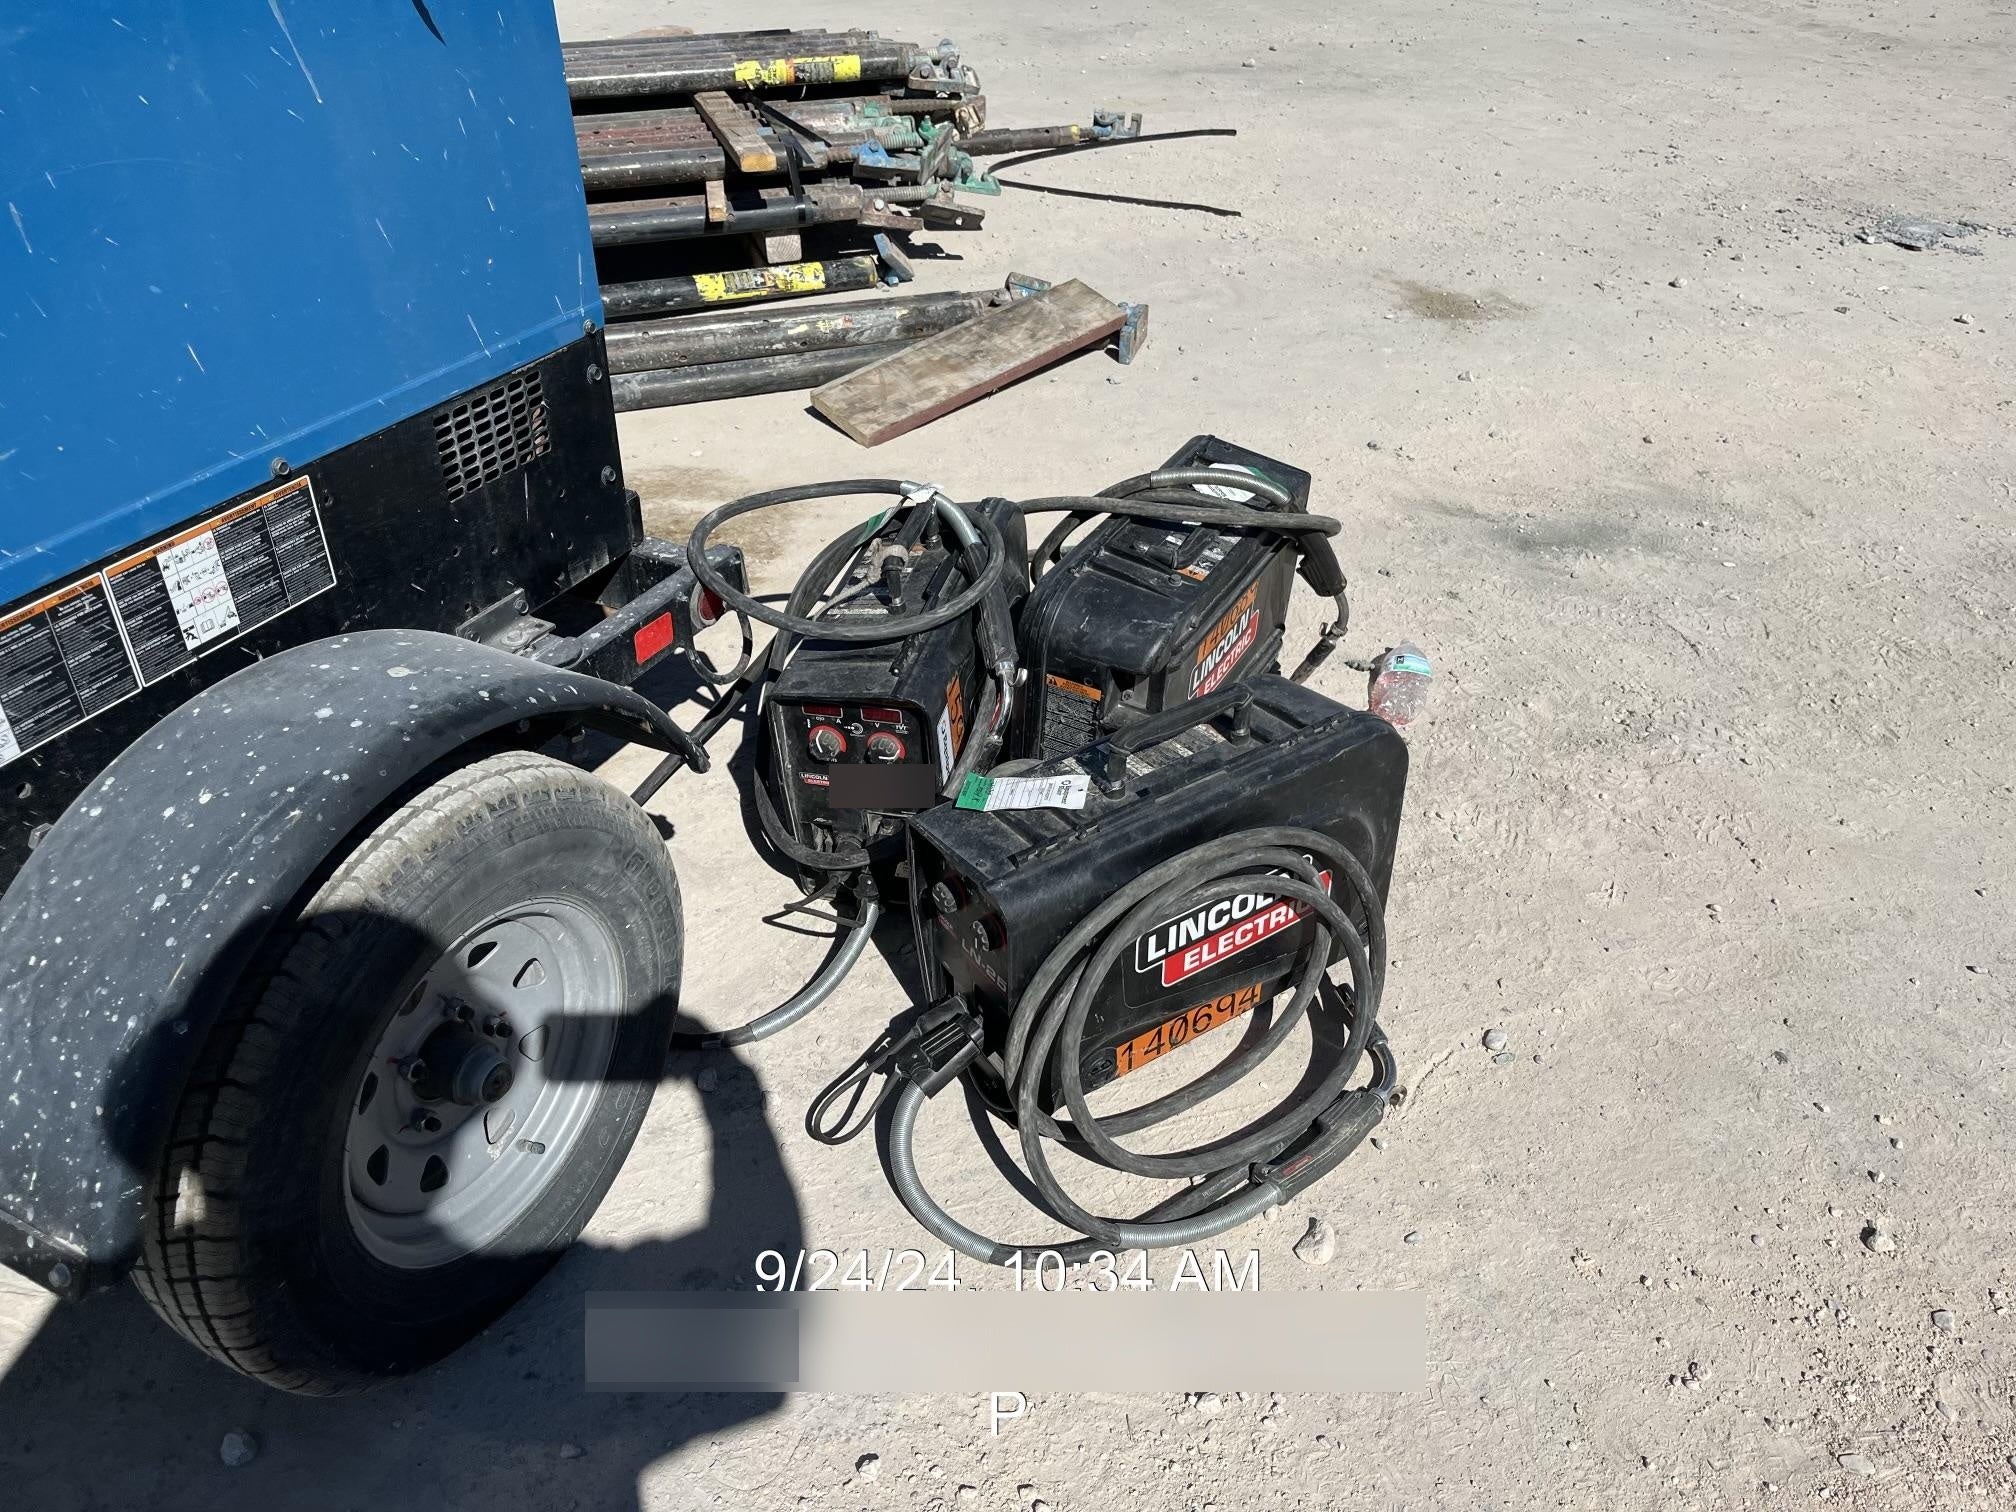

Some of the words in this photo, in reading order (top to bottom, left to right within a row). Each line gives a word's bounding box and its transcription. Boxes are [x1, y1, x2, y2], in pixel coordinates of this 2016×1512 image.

[1192, 607, 1250, 691] LINCOLN
[1203, 627, 1252, 695] ELECTRIC
[1121, 985, 1258, 1071] 140694
